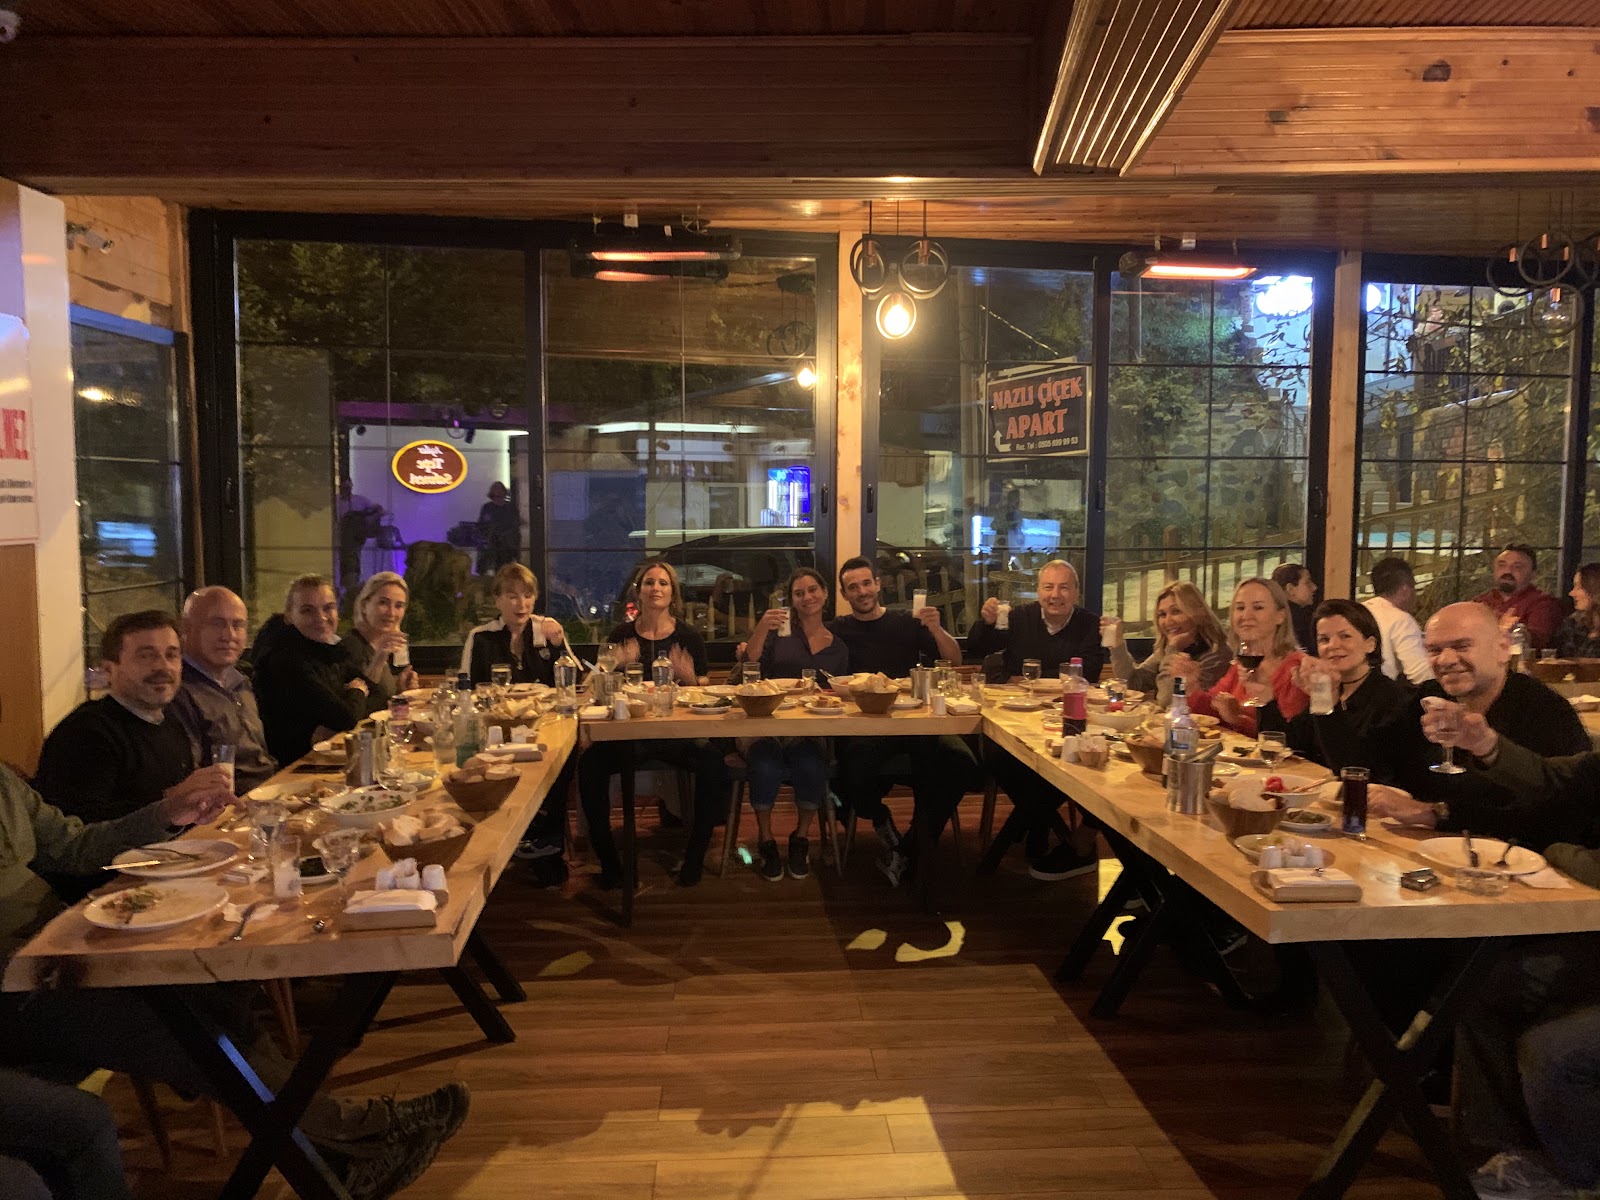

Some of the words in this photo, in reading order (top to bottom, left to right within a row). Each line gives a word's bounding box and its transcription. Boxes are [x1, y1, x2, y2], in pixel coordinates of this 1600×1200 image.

[992, 385, 1034, 410] NAZLI
[1037, 377, 1083, 408] ÇİÇEK
[1006, 408, 1068, 440] APART
